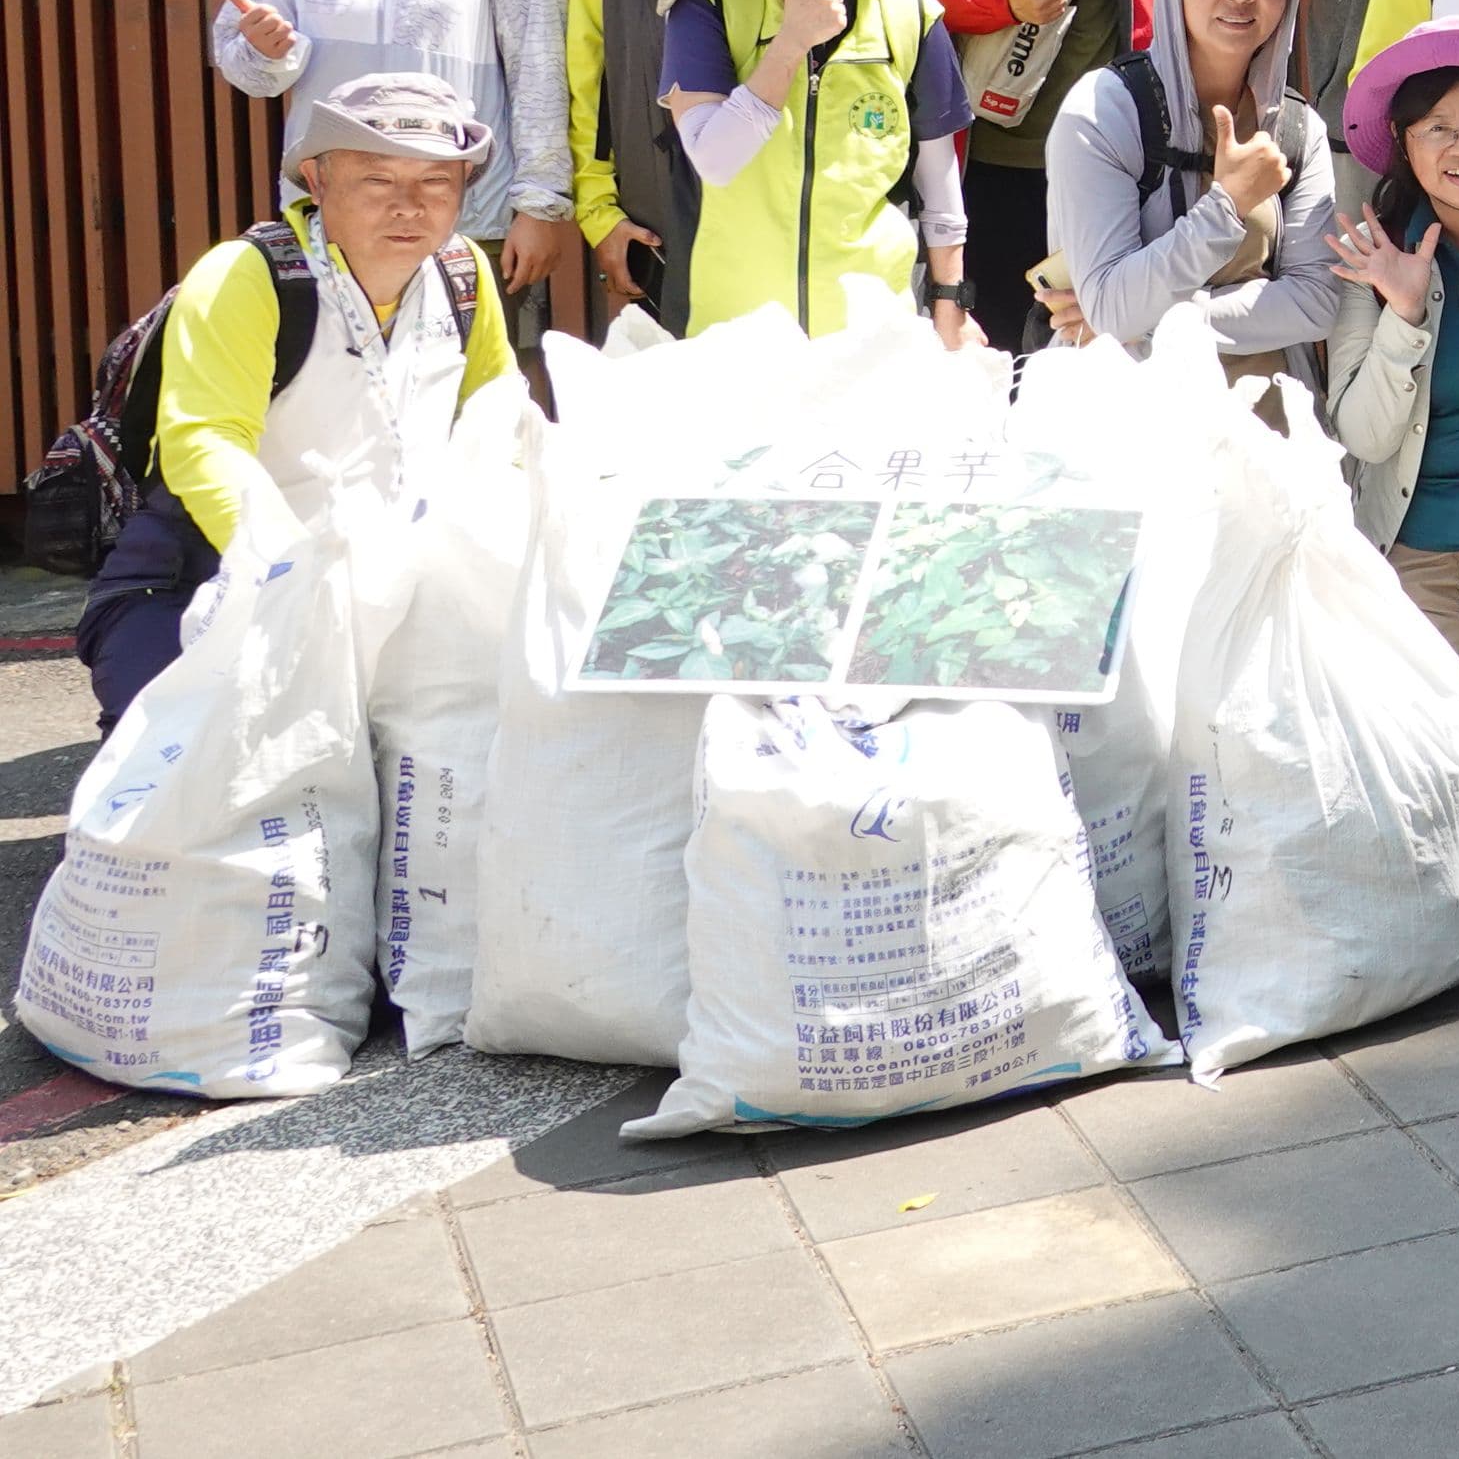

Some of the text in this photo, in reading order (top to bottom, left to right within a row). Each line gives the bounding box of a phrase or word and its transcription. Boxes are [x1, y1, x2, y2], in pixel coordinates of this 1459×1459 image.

[801, 449, 1000, 493] 合果芋
[261, 816, 296, 936] 虱目魚用
[798, 1019, 1026, 1075] www.oceanfeed.com.tw
[903, 1003, 1024, 1053] 0800-783705
[964, 1048, 1040, 1090] 淨重30公斤
